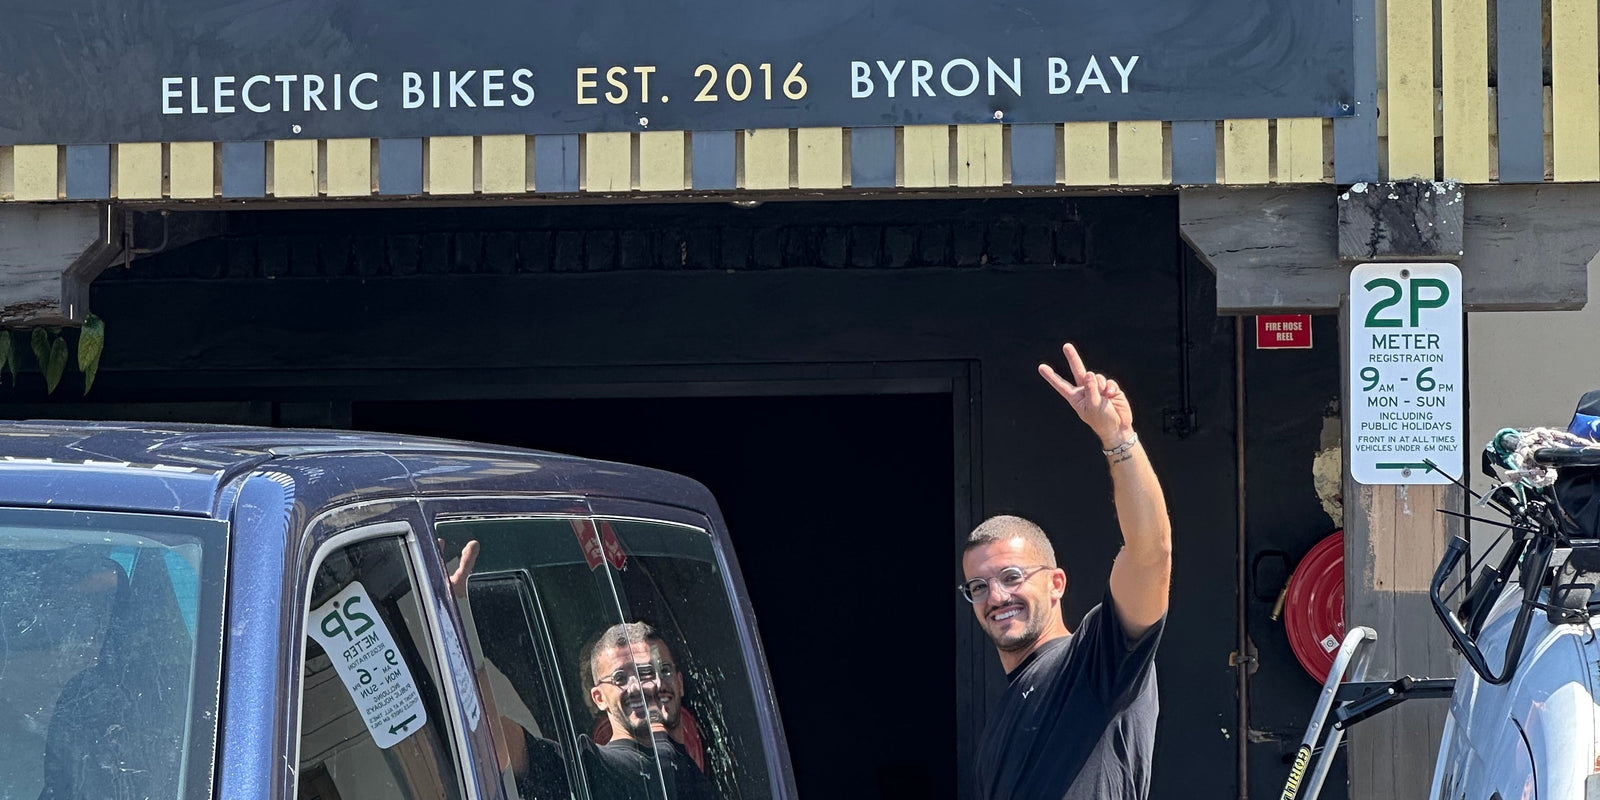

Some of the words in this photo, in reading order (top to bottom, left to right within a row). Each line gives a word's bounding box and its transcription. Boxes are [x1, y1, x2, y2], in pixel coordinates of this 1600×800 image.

[162, 72, 378, 114] ELECTRIC
[402, 68, 535, 109] BIKES
[576, 65, 669, 105] EST.
[694, 61, 808, 102] 2016
[851, 56, 1022, 99] BYRON
[1048, 54, 1140, 95] BAY
[1363, 277, 1450, 328] 2P
[1265, 322, 1282, 331] FIRE
[1282, 321, 1303, 331] HOSE
[1276, 332, 1294, 341] REEL
[1372, 333, 1440, 350] METER
[1369, 353, 1444, 363] REGISTRATION
[1367, 396, 1398, 408] MON
[1416, 396, 1446, 408] SUN
[1379, 411, 1434, 421] INCLUDING
[1361, 422, 1398, 431] PUBLIC
[1401, 422, 1452, 431] HOLIDAYS
[1358, 435, 1385, 443] FRONT
[1388, 435, 1396, 443] IN
[1399, 435, 1410, 443] AT
[1412, 435, 1429, 443] ALL
[1432, 435, 1456, 443] TIMES
[1355, 444, 1393, 452] VEHICLES
[1395, 444, 1421, 452] UNDER
[1424, 444, 1436, 452] 6M
[1438, 444, 1459, 452] ONLY
